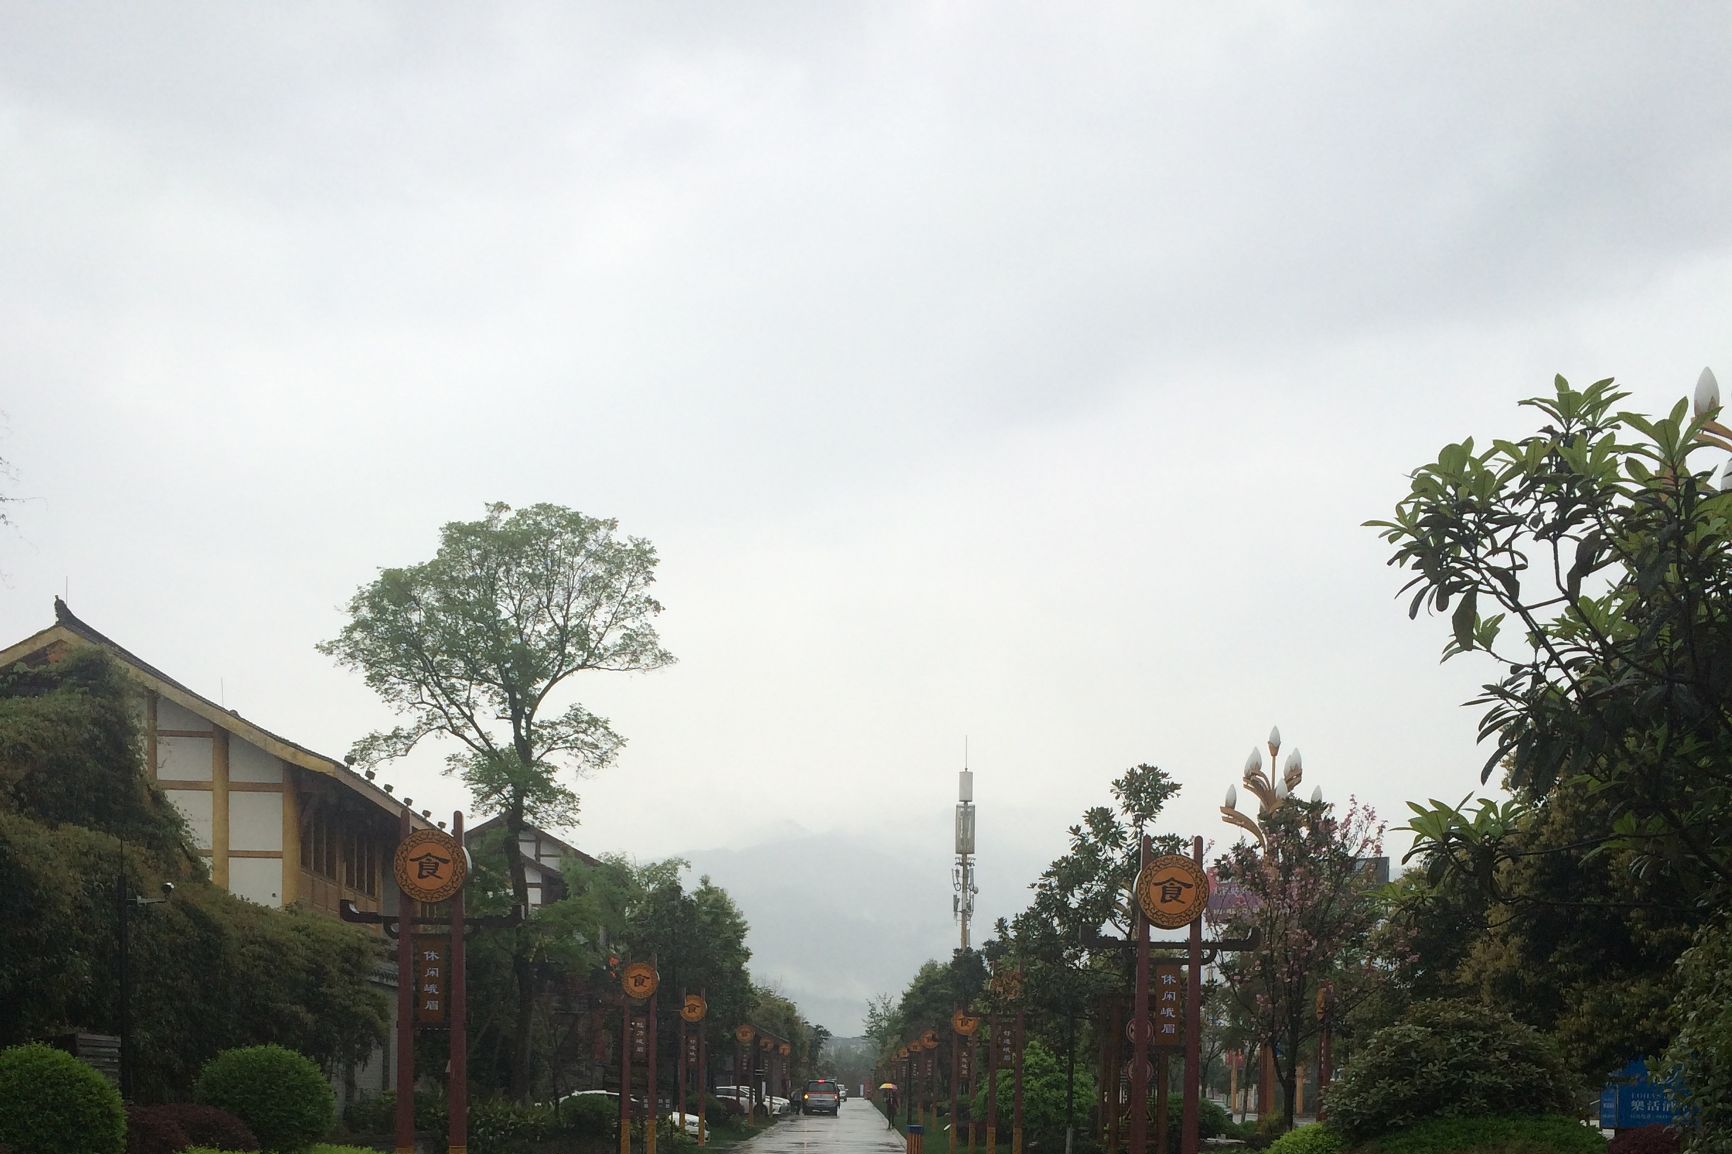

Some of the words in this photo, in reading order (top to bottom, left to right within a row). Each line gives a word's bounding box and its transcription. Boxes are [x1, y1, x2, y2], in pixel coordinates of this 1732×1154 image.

[409, 852, 450, 880] 食
[1152, 876, 1193, 904] 食
[423, 949, 440, 1012] 休闲峨眉
[630, 973, 650, 987] 食
[1160, 973, 1177, 1035] 休闲峨眉
